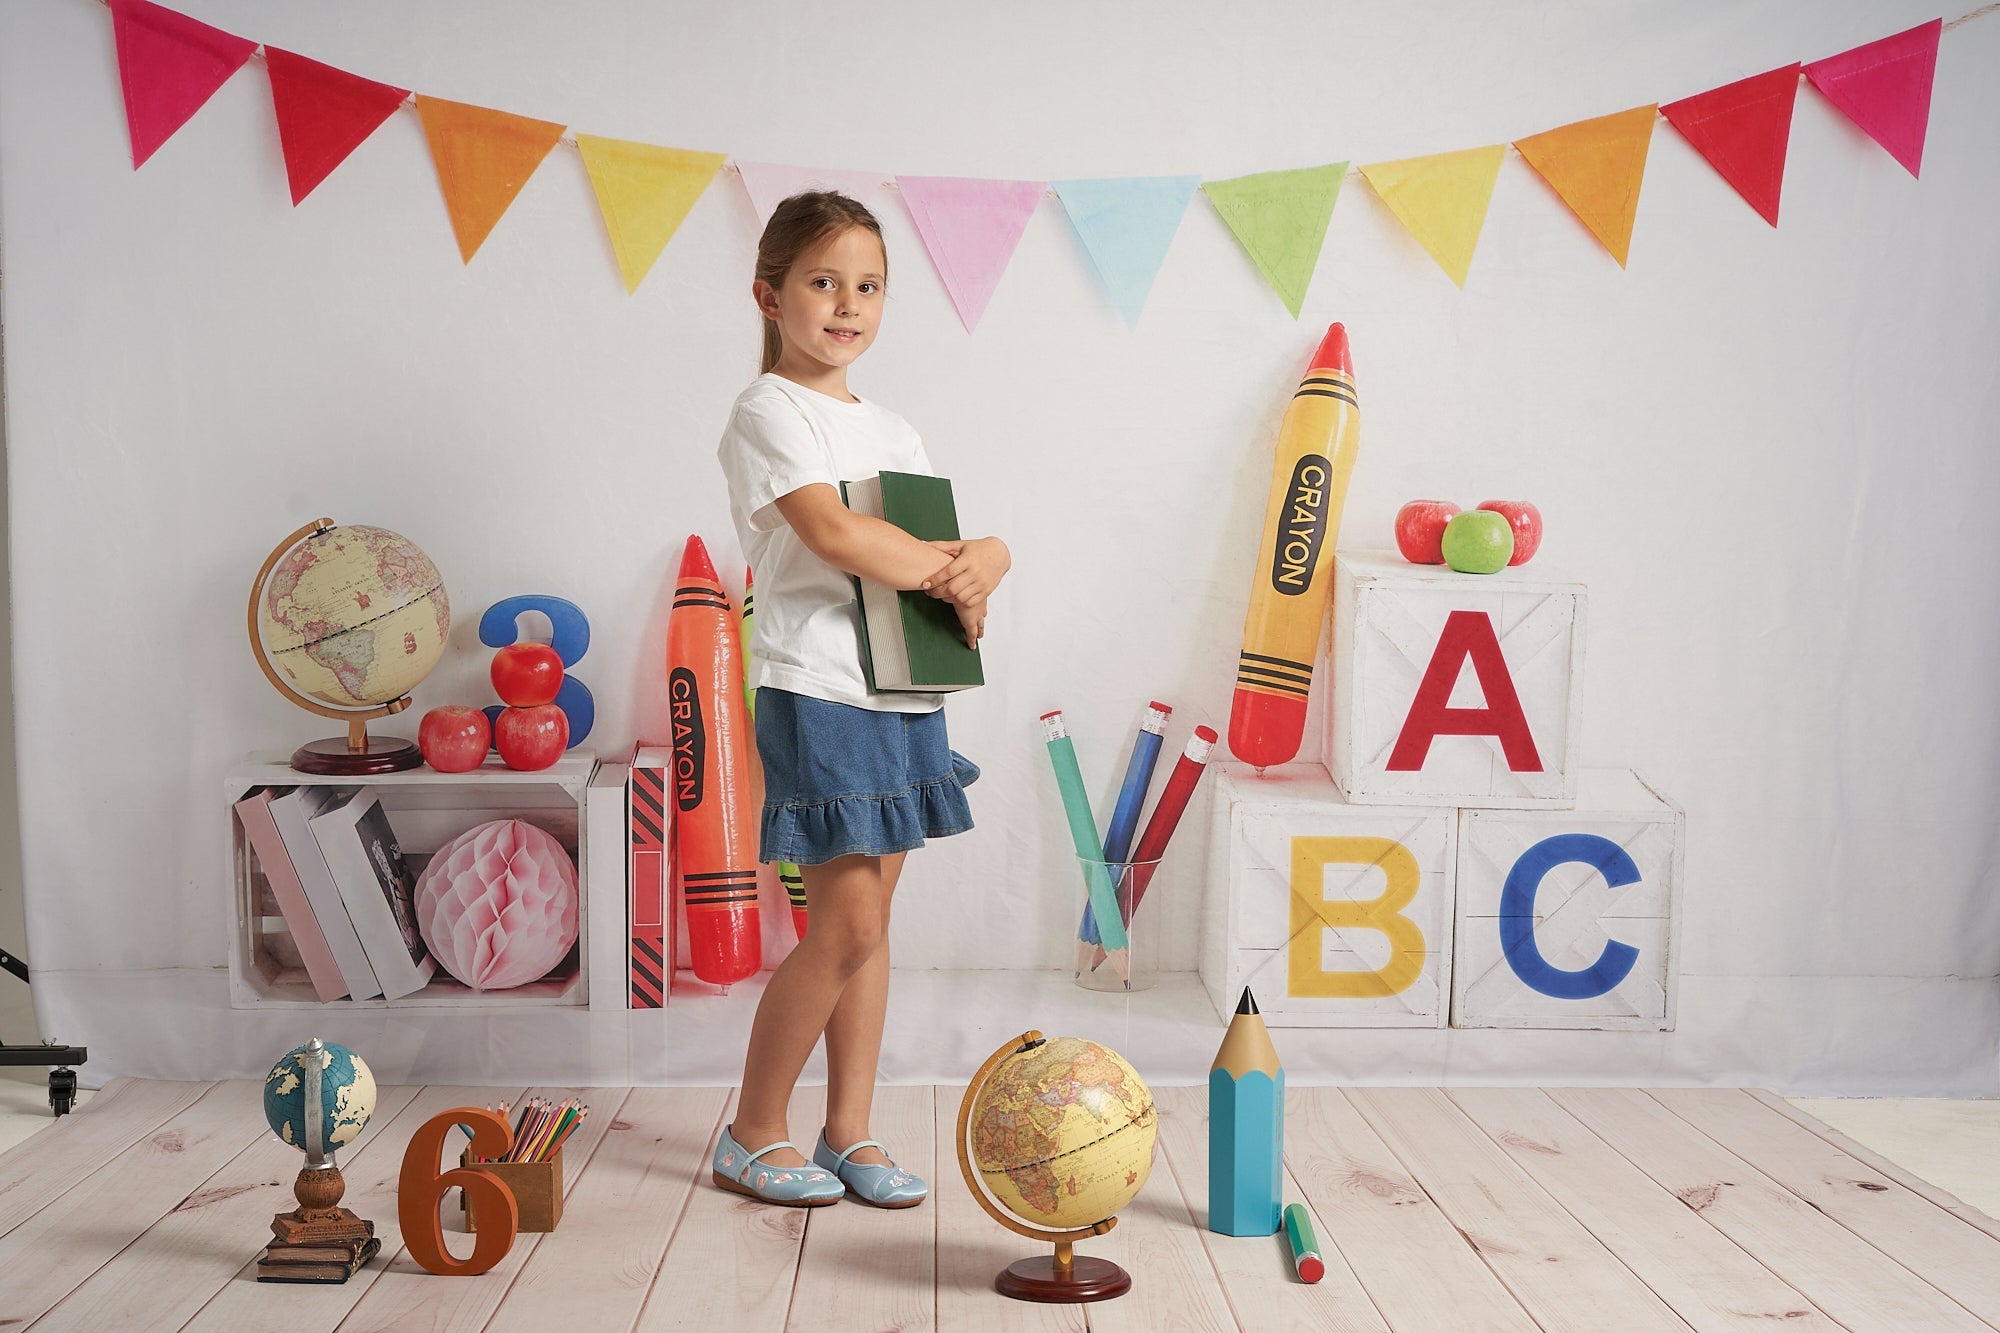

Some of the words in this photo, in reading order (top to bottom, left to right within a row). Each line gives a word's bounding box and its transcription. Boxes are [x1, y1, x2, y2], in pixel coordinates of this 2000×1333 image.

[1279, 465, 1326, 586] CRAYON
[672, 678, 697, 800] CRAYON
[1385, 610, 1544, 772] A
[1288, 836, 1426, 998] B
[1499, 833, 1642, 1000] C
[398, 1107, 519, 1276] 6
